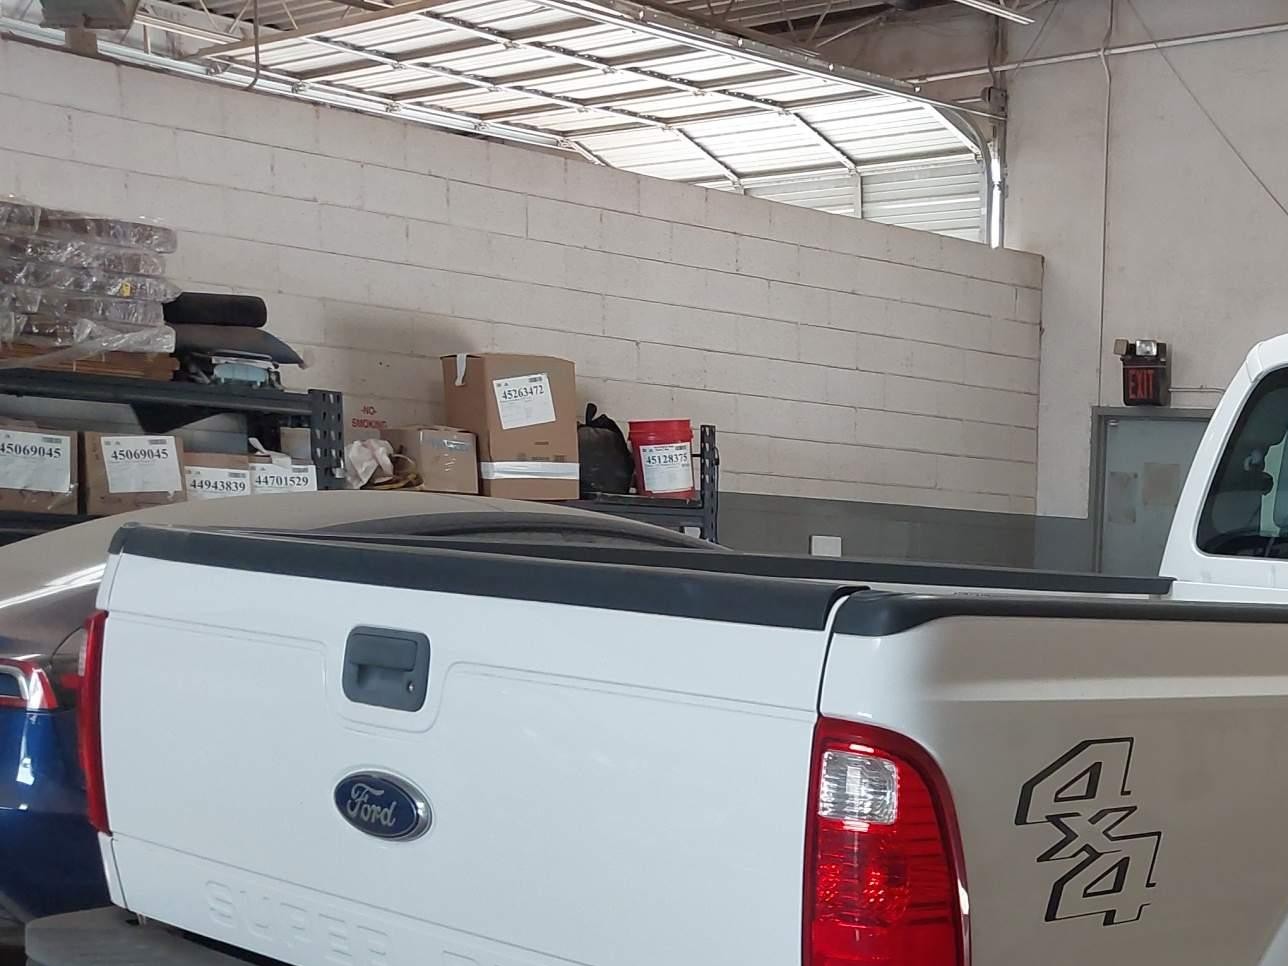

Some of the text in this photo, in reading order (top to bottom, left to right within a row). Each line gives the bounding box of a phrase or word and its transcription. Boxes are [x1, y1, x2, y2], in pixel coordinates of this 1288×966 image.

[1128, 367, 1154, 400] EXIT
[502, 384, 545, 400] 45263472
[0, 442, 62, 459] 45069045
[111, 448, 169, 461] 45069045
[646, 452, 688, 465] 45128375
[189, 478, 246, 492] 44943839
[255, 474, 309, 487] 44701529
[346, 782, 398, 827] Ford
